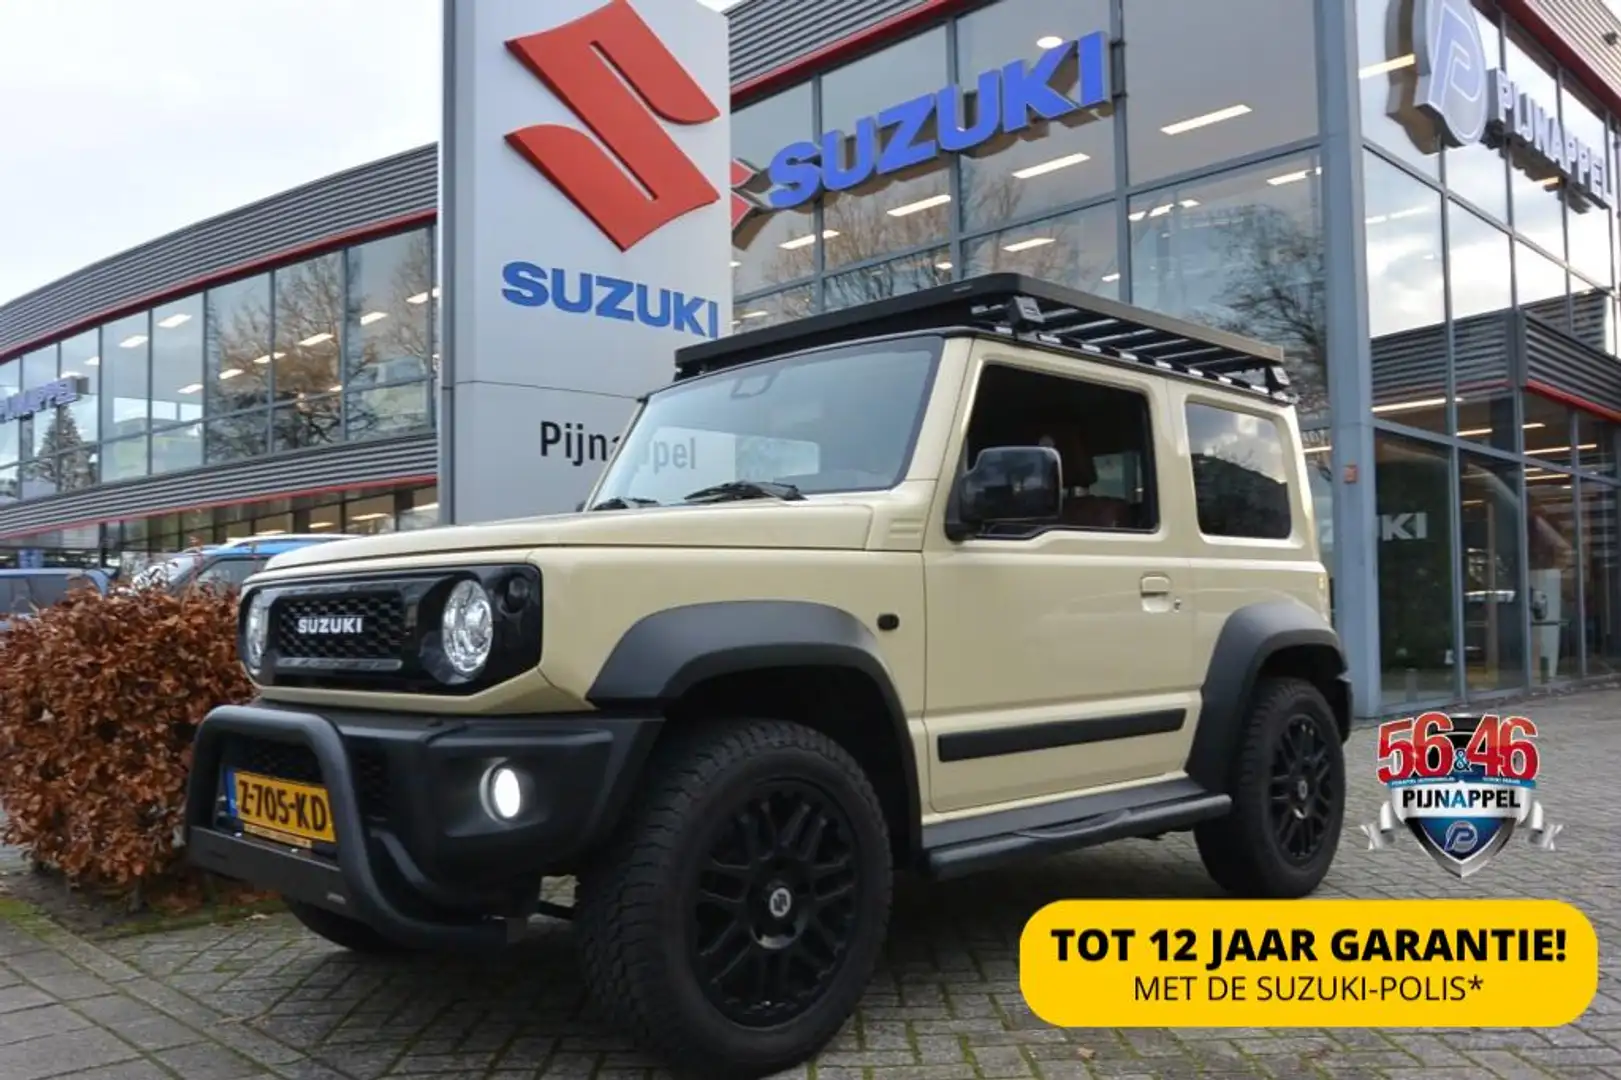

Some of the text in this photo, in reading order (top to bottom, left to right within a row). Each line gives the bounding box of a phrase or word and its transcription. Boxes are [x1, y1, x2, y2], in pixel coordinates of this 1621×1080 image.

[767, 30, 1110, 210] SUZUKI
[1496, 68, 1615, 210] PIJNAPPEL
[501, 261, 719, 341] SUZUKI
[298, 616, 363, 634] SUZUKI
[238, 779, 327, 832] Z-705-KD
